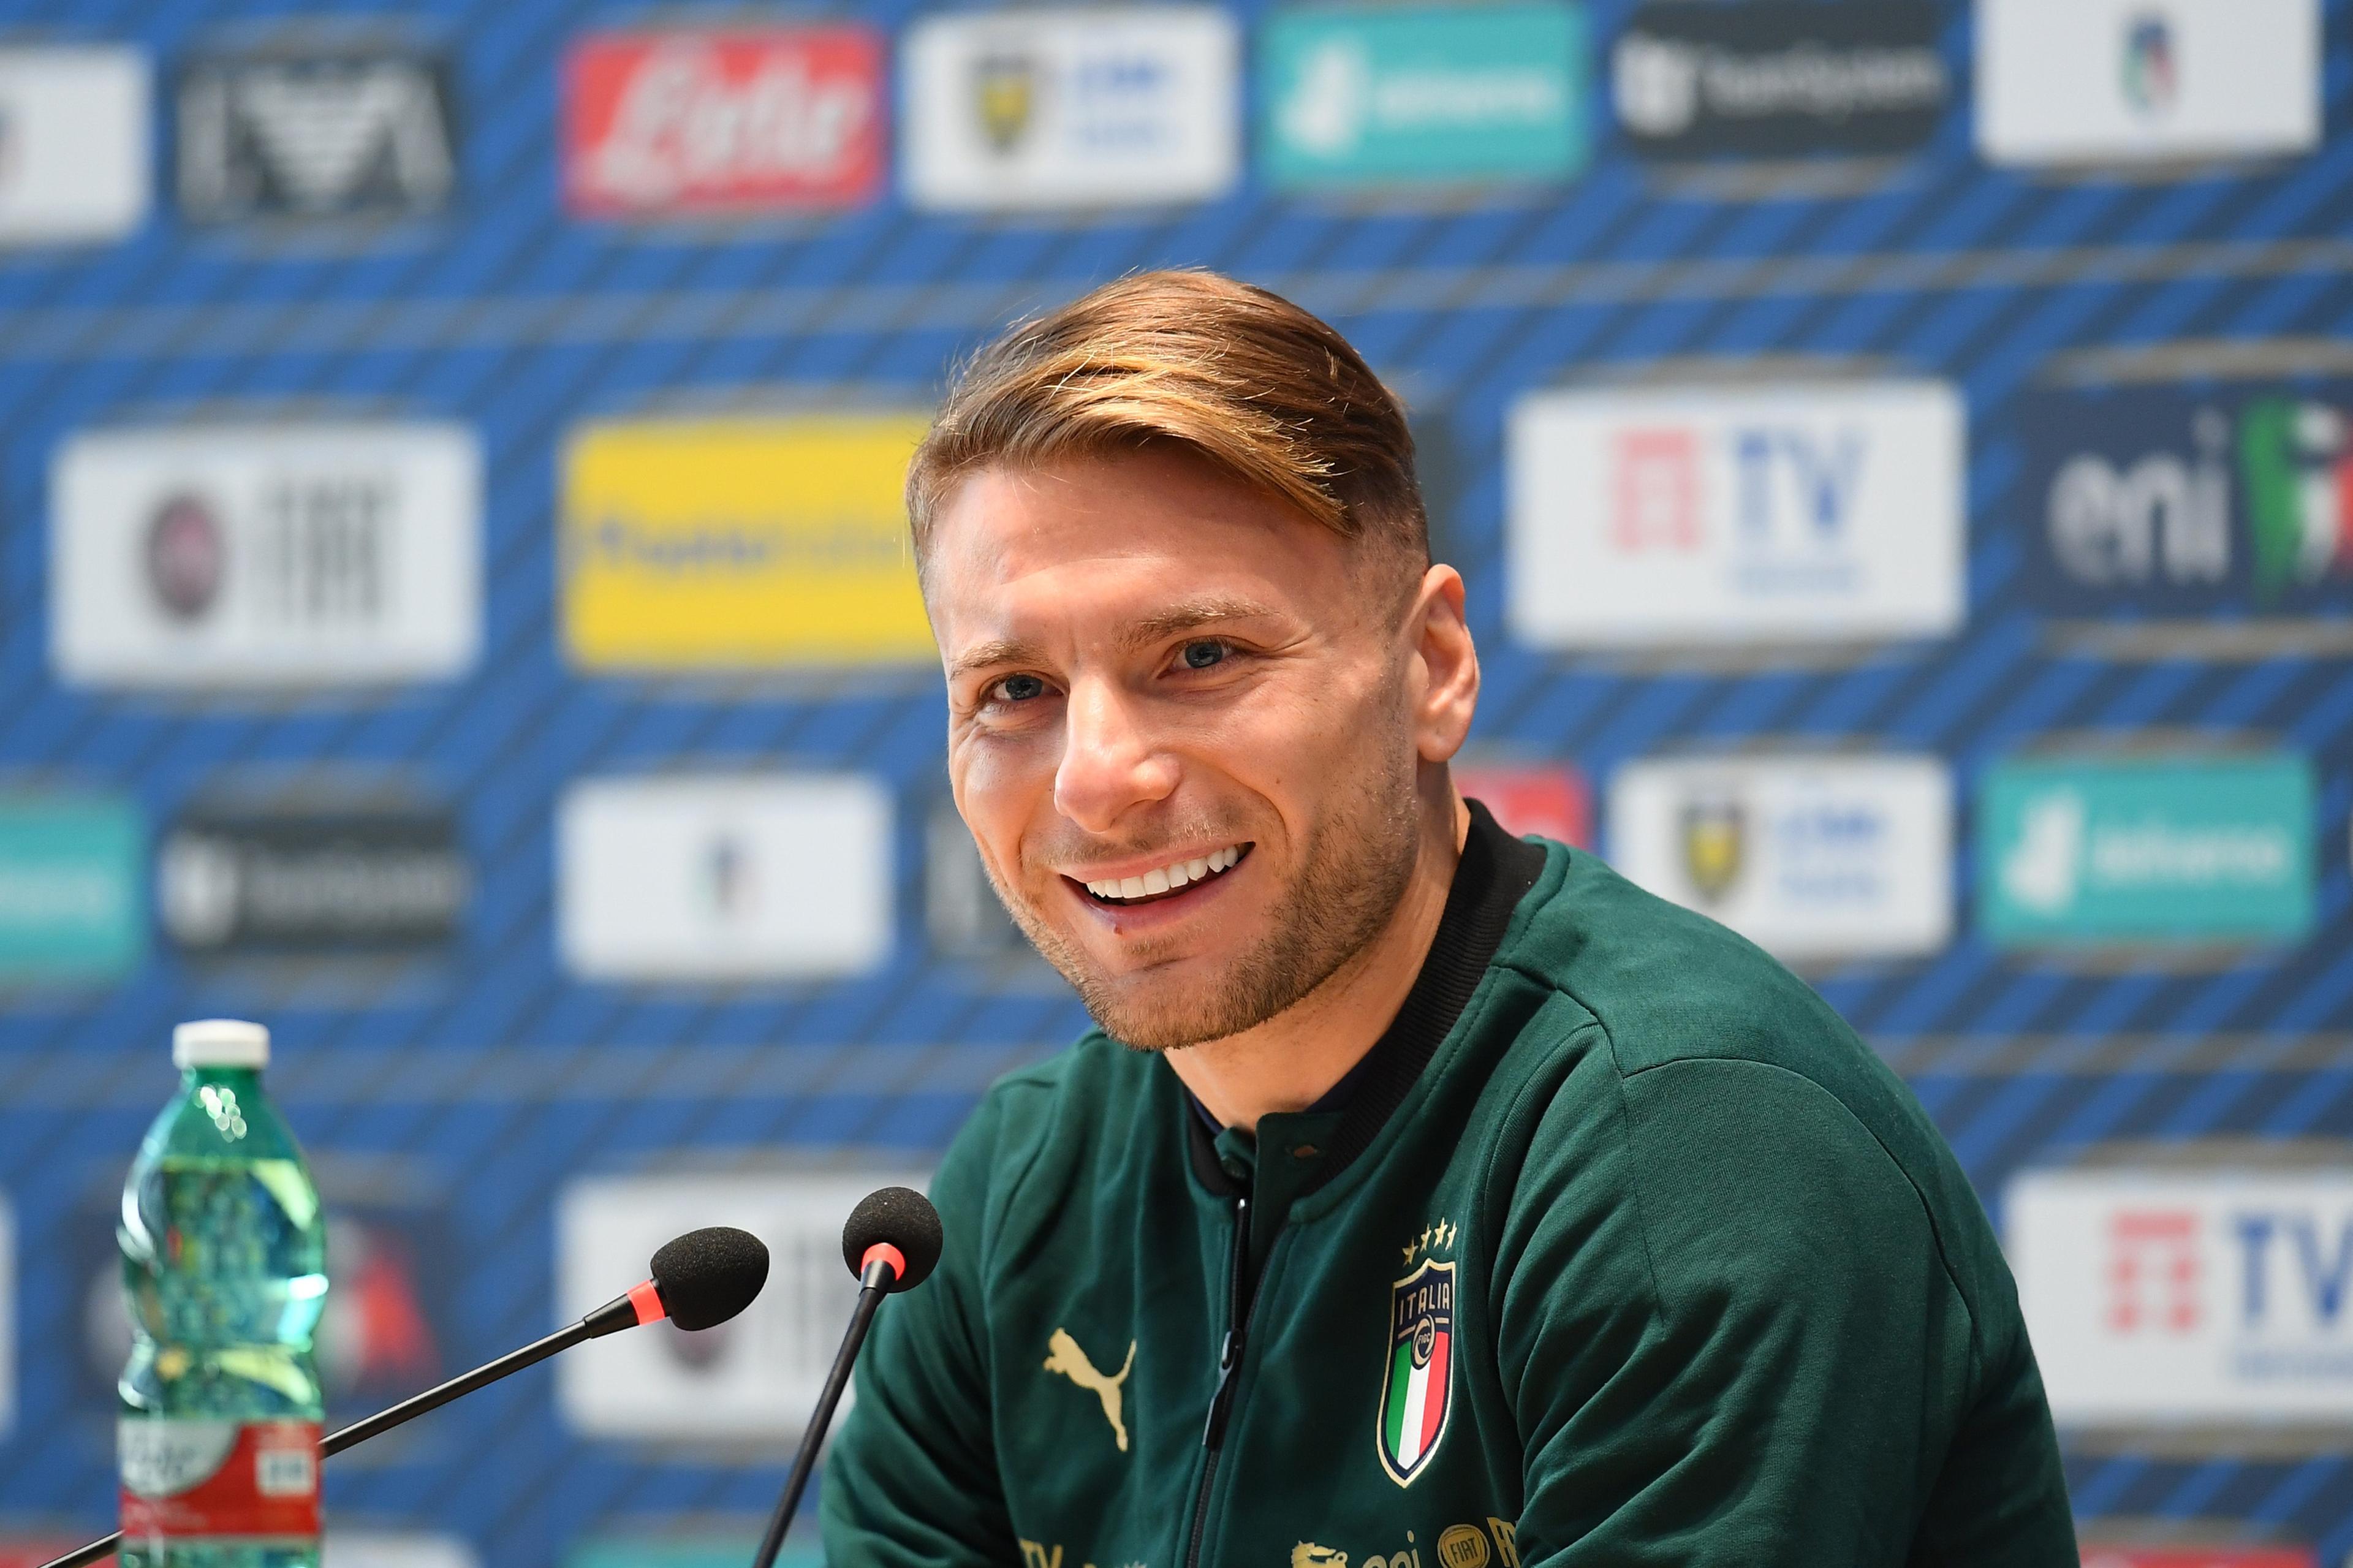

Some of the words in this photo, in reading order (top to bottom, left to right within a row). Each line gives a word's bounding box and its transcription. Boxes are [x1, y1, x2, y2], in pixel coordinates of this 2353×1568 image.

[1727, 426, 1869, 539] TV
[2050, 406, 2230, 583] eni
[1399, 1282, 1450, 1325] ITALIA
[2226, 1210, 2353, 1327] TV
[1450, 1537, 1478, 1564] FIAT
